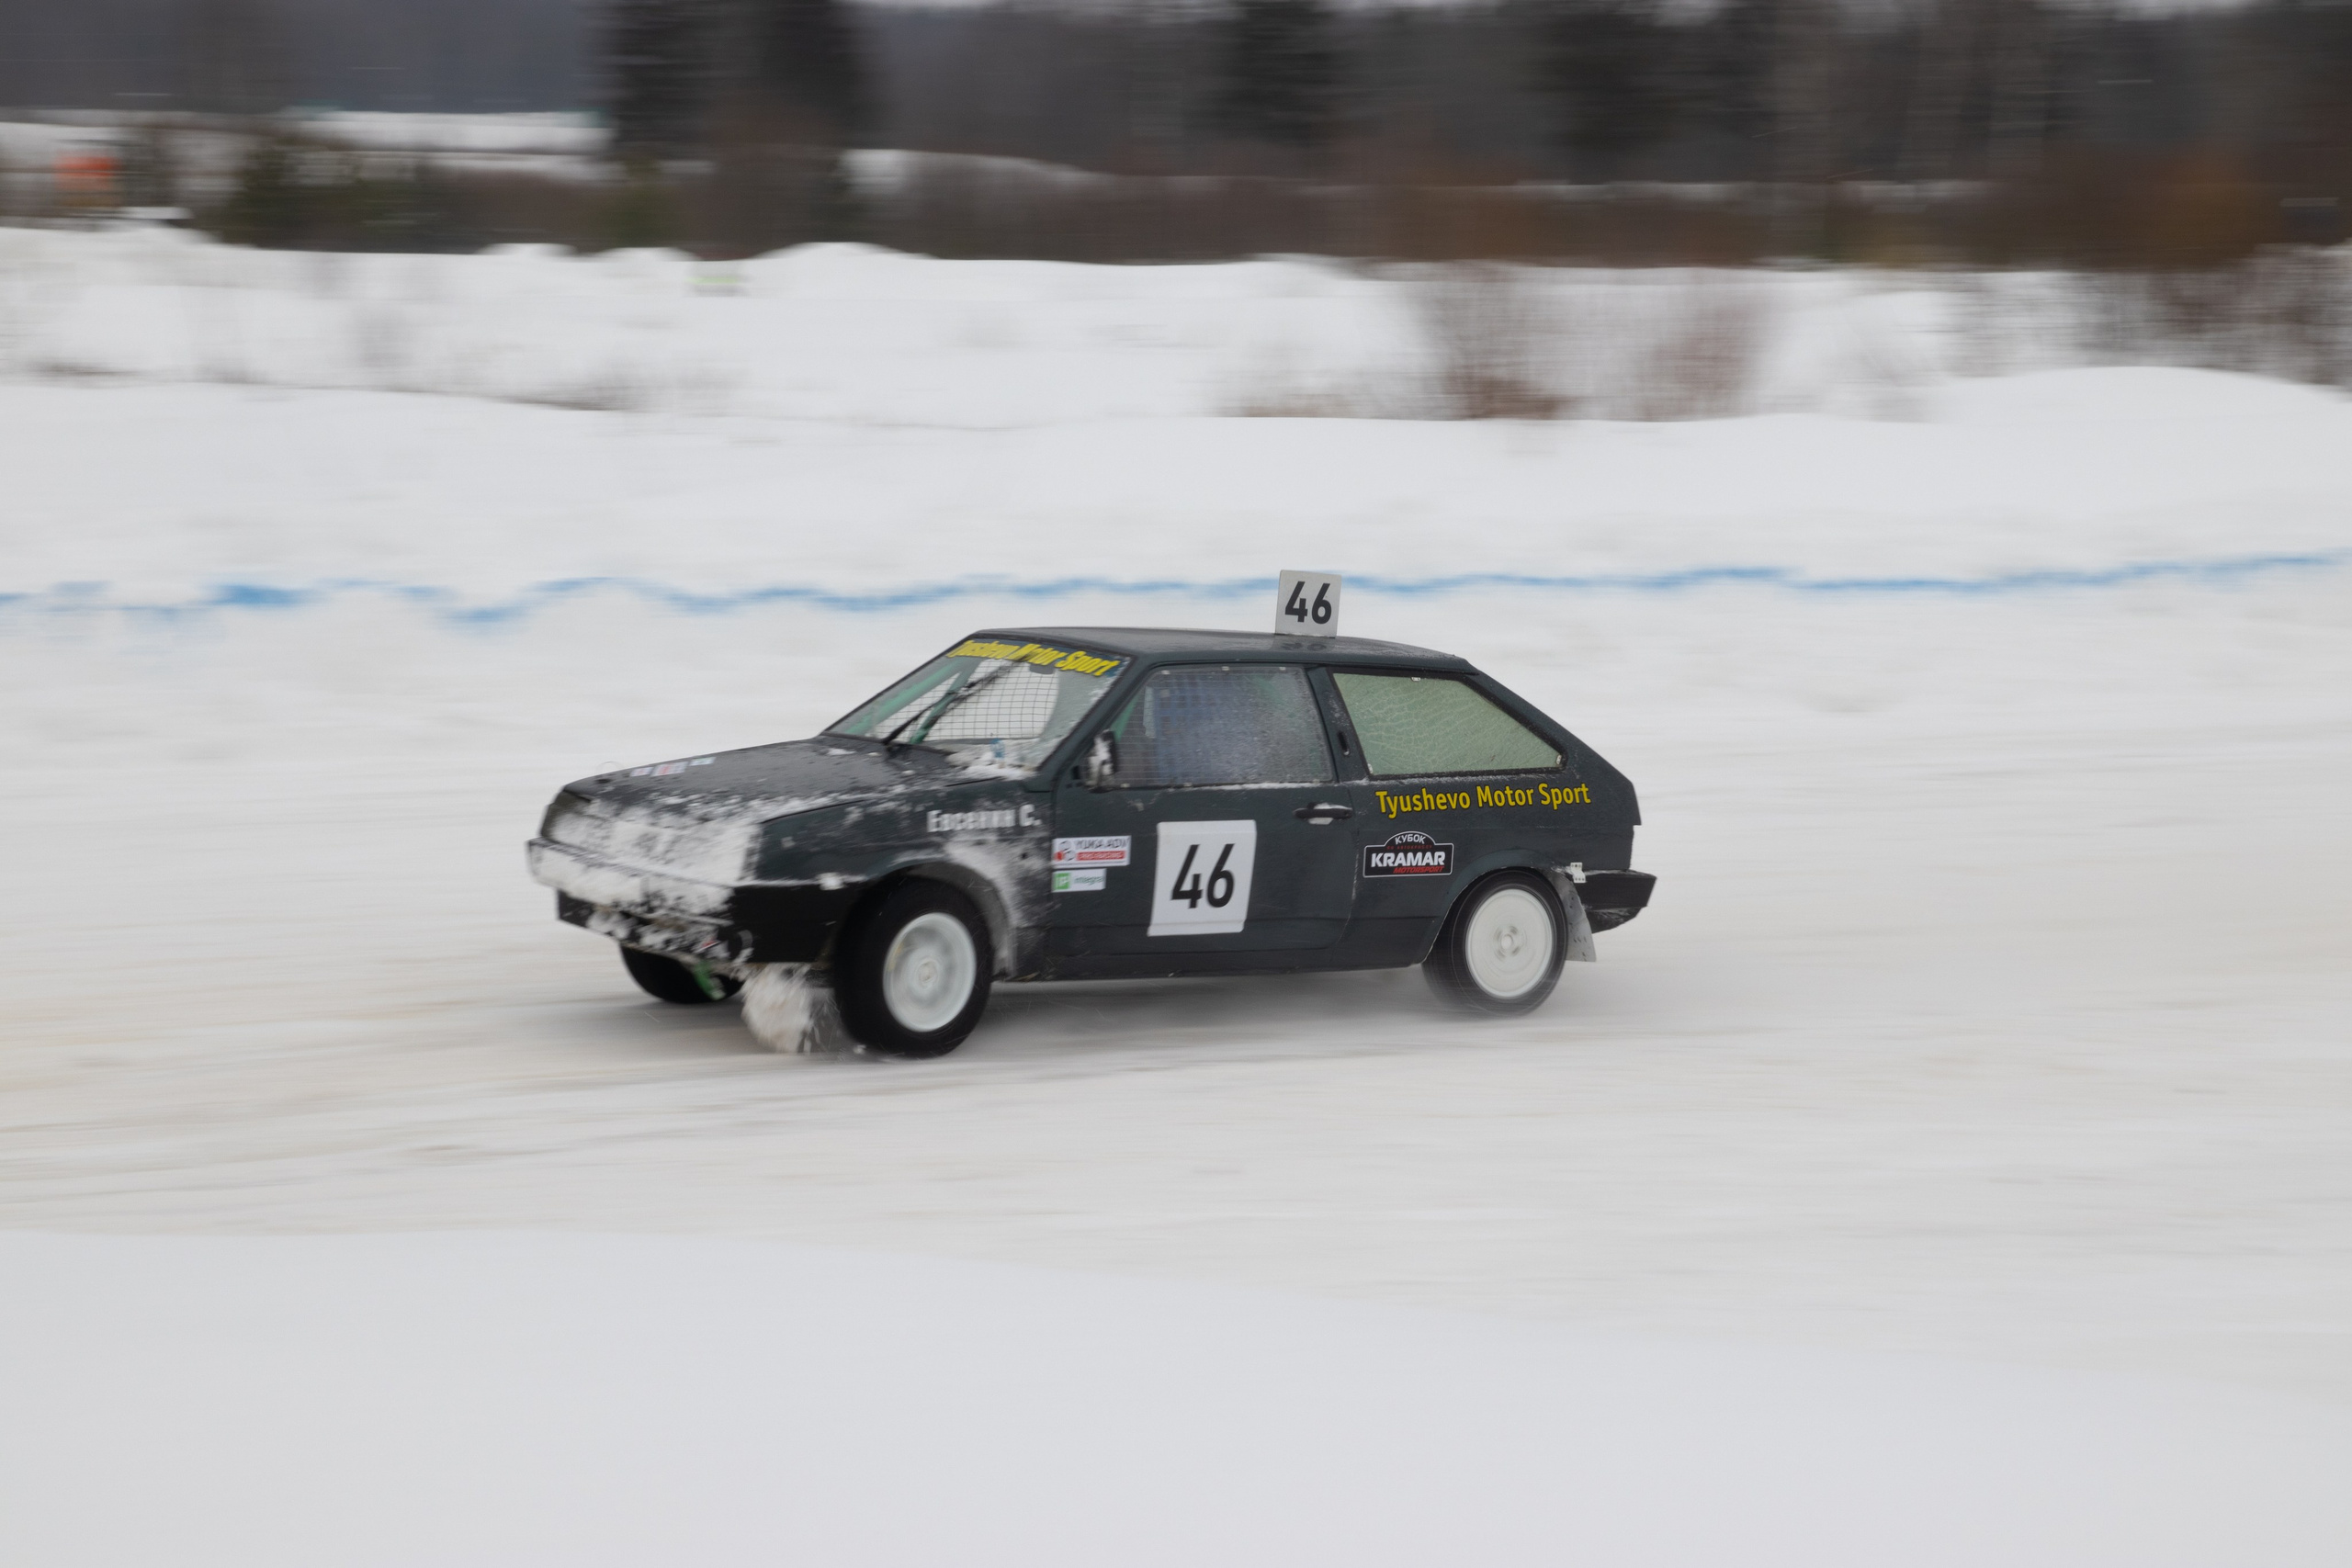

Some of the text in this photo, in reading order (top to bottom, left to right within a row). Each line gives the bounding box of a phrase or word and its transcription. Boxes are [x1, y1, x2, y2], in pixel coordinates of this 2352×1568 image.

[1284, 581, 1332, 625] 46
[1055, 650, 1122, 677] Sport
[1375, 783, 1592, 819] Tyushevo Motor Sport
[1395, 833, 1426, 845] КУБОК
[1371, 851, 1446, 868] KRAMAR
[1393, 865, 1445, 874] MOTORSPORT
[1170, 842, 1236, 909] 46
